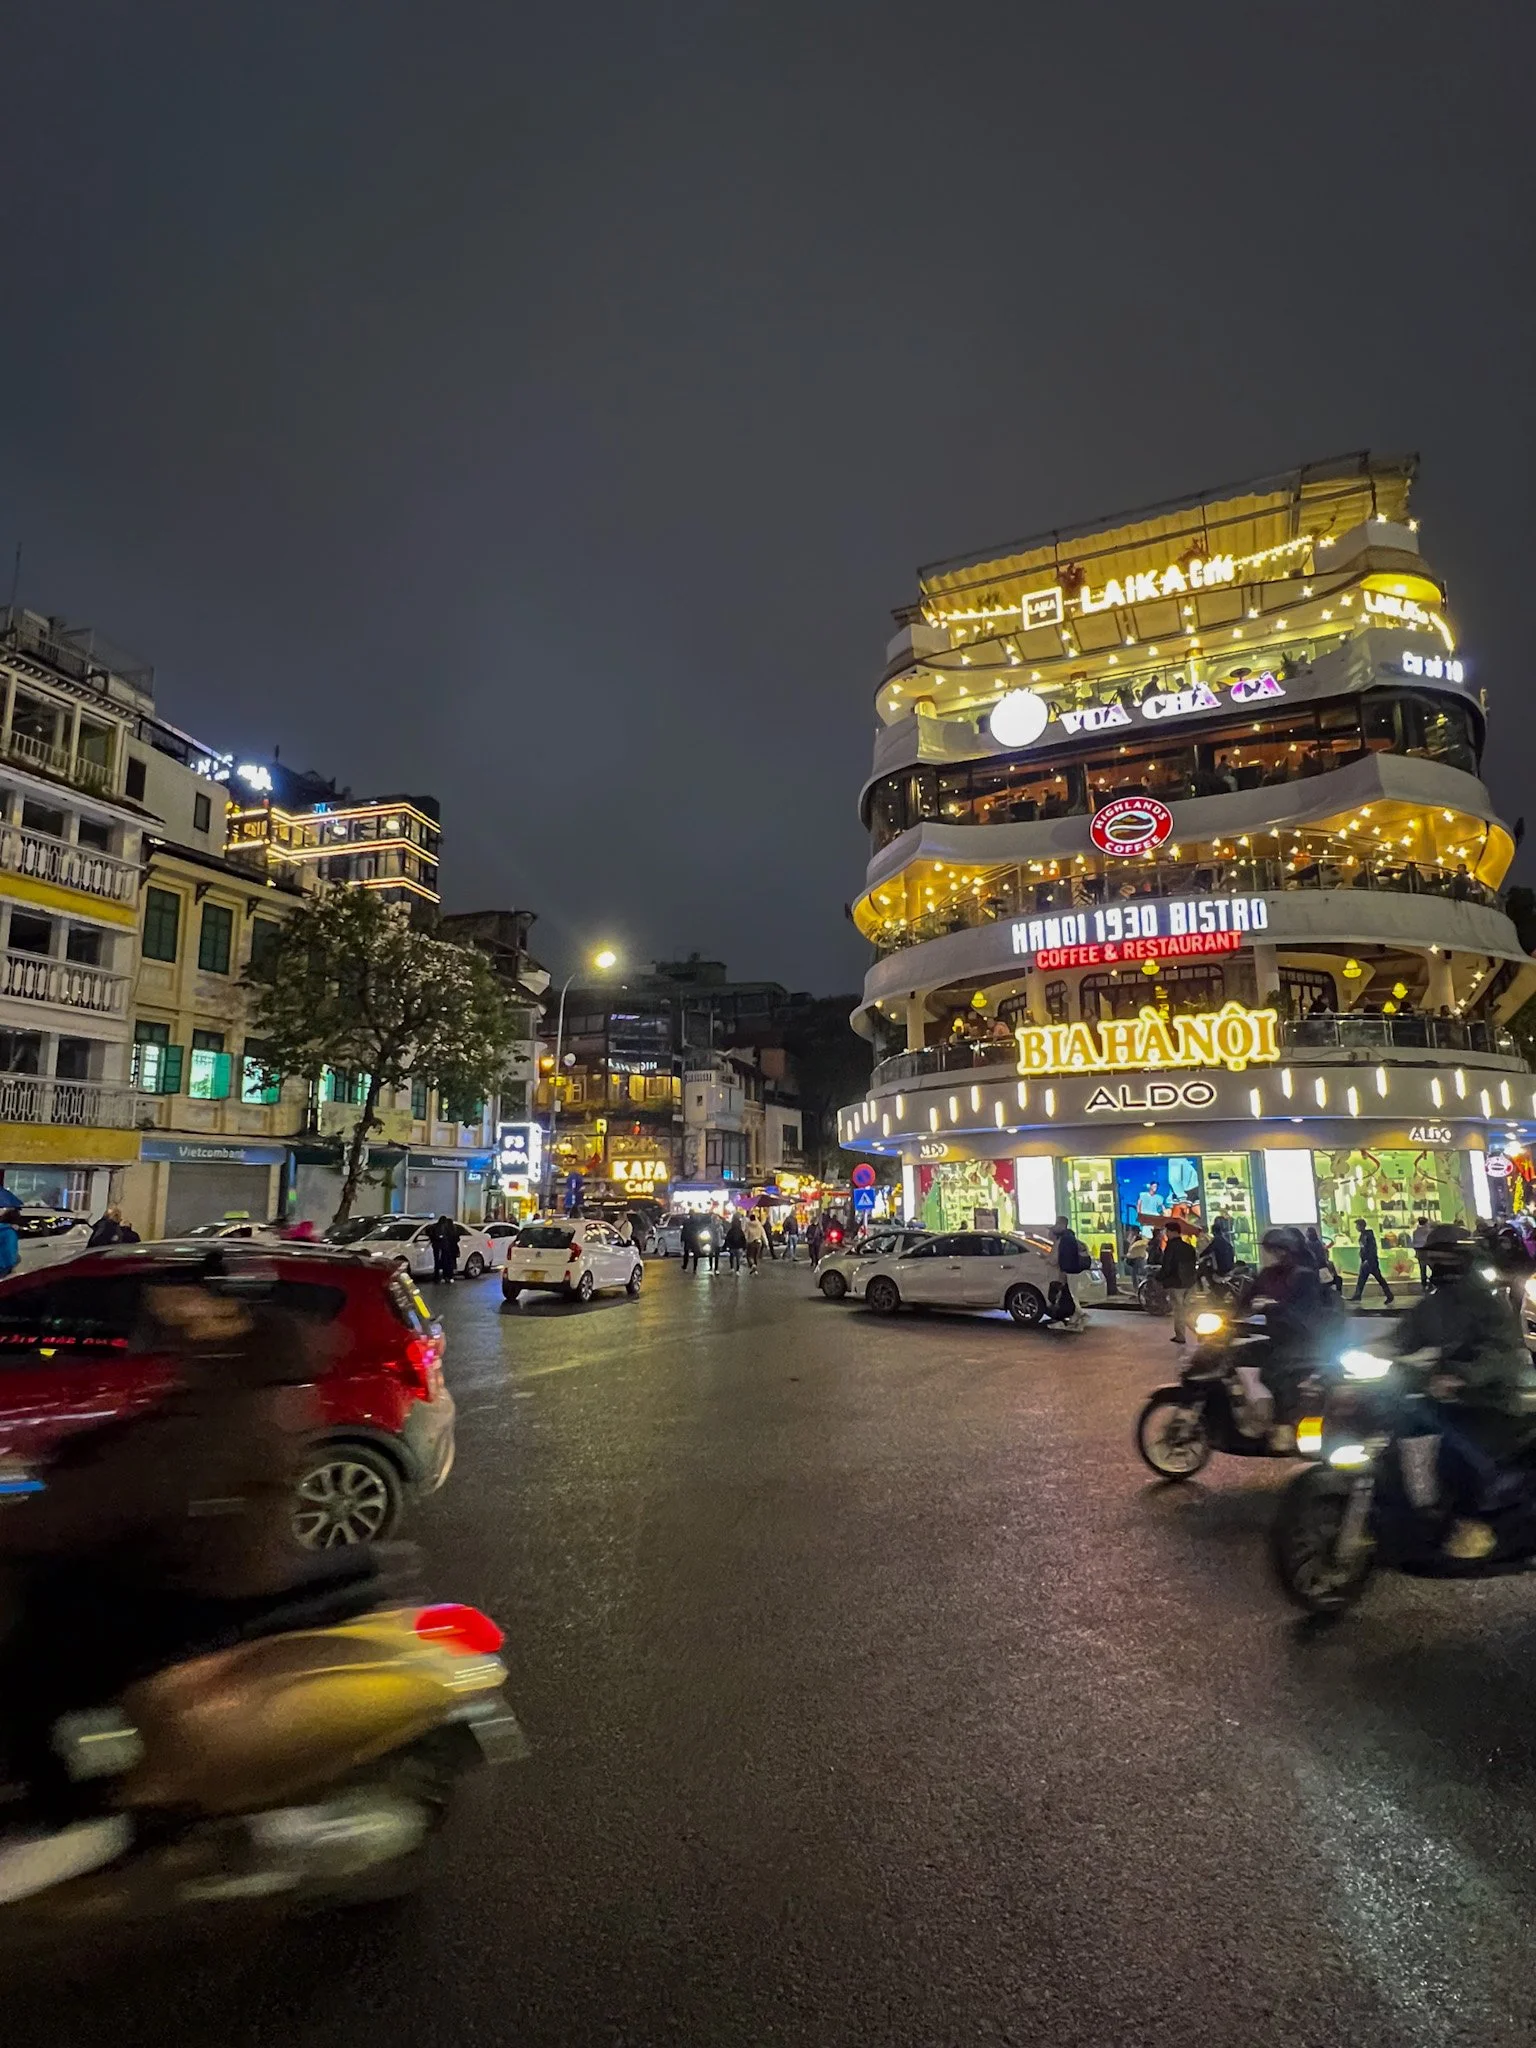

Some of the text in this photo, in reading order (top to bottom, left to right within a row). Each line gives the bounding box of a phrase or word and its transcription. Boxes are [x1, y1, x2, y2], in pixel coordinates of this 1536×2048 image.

[1081, 565, 1187, 614] LAIKA
[1059, 704, 1132, 734] VUA
[1231, 671, 1286, 703] CÁ
[1095, 801, 1167, 829] HIGHLANDS
[1105, 835, 1161, 853] COFFEE
[1012, 898, 1268, 954] HANOI 1930 BISTRO
[1037, 931, 1242, 969] COFFEE & RESTAURANT
[1018, 1025, 1099, 1073] BIA
[1086, 1081, 1216, 1112] ALDO
[1409, 1127, 1451, 1143] ALDO
[179, 1146, 247, 1159] Vietcombank
[612, 1161, 668, 1180] KAFA
